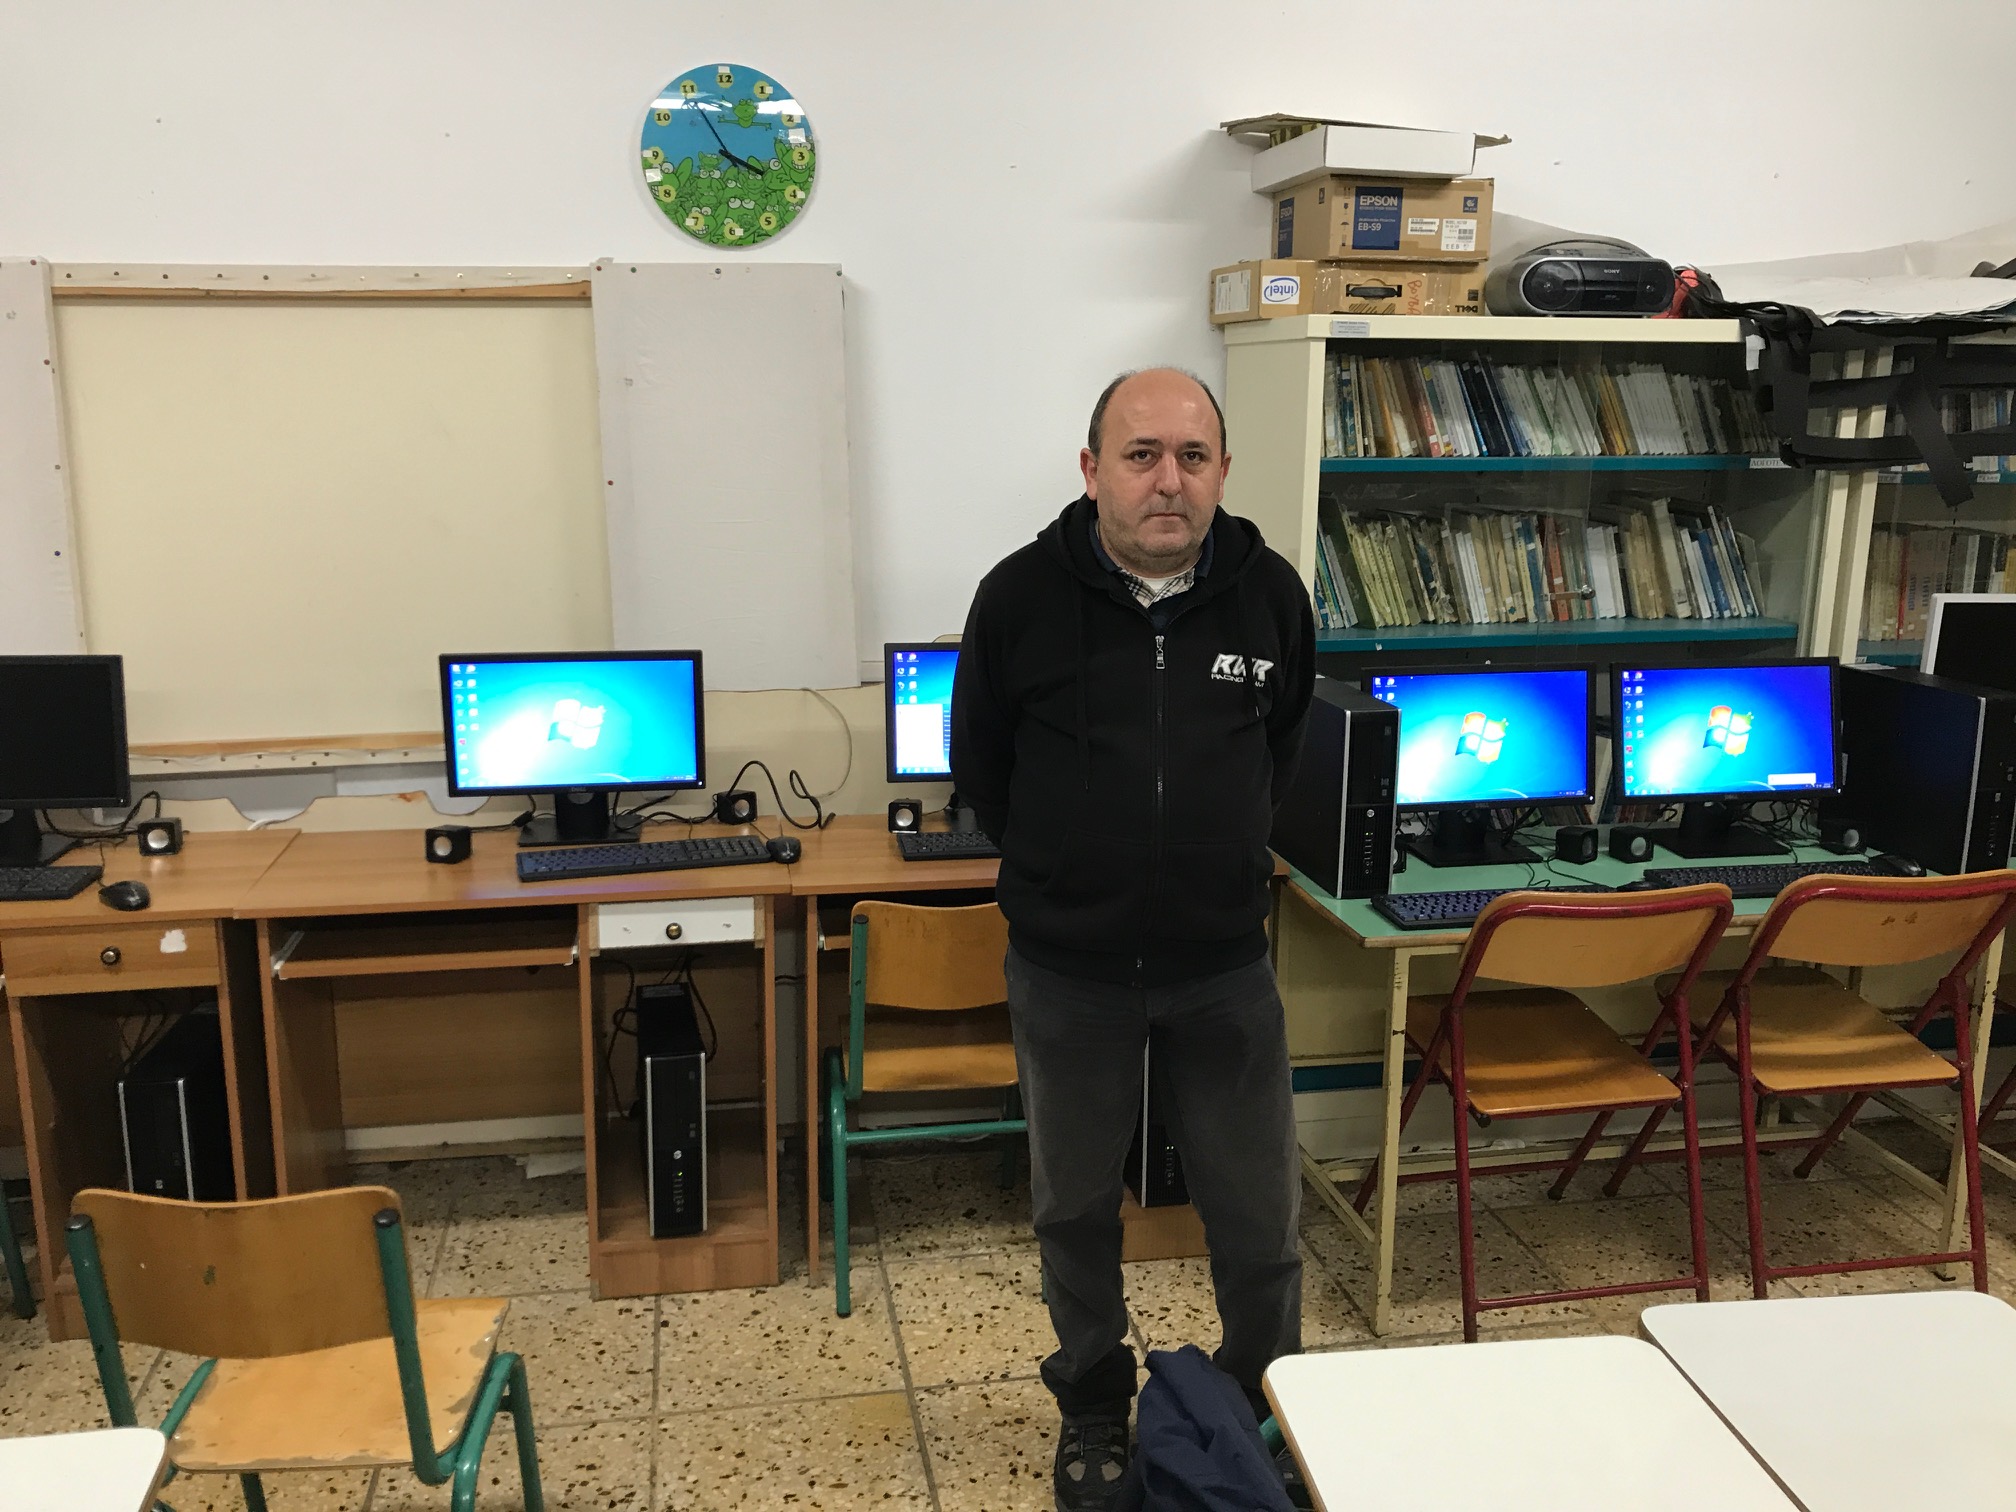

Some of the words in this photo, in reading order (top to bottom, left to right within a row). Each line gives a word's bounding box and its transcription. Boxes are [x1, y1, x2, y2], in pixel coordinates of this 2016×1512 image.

[718, 74, 733, 83] 12
[681, 85, 696, 93] 11
[759, 85, 766, 94] 1
[656, 113, 671, 121] 10
[786, 114, 794, 122] 2
[652, 151, 660, 160] 9
[797, 151, 806, 161] 3
[663, 189, 672, 198] 8
[789, 190, 798, 199] 4
[1359, 195, 1398, 207] EPSON
[692, 217, 700, 226] 7
[764, 217, 772, 226] 5
[1358, 222, 1382, 231] EB-S9
[729, 227, 736, 236] 6
[1270, 285, 1294, 297] intel
[1455, 305, 1478, 314] DELL
